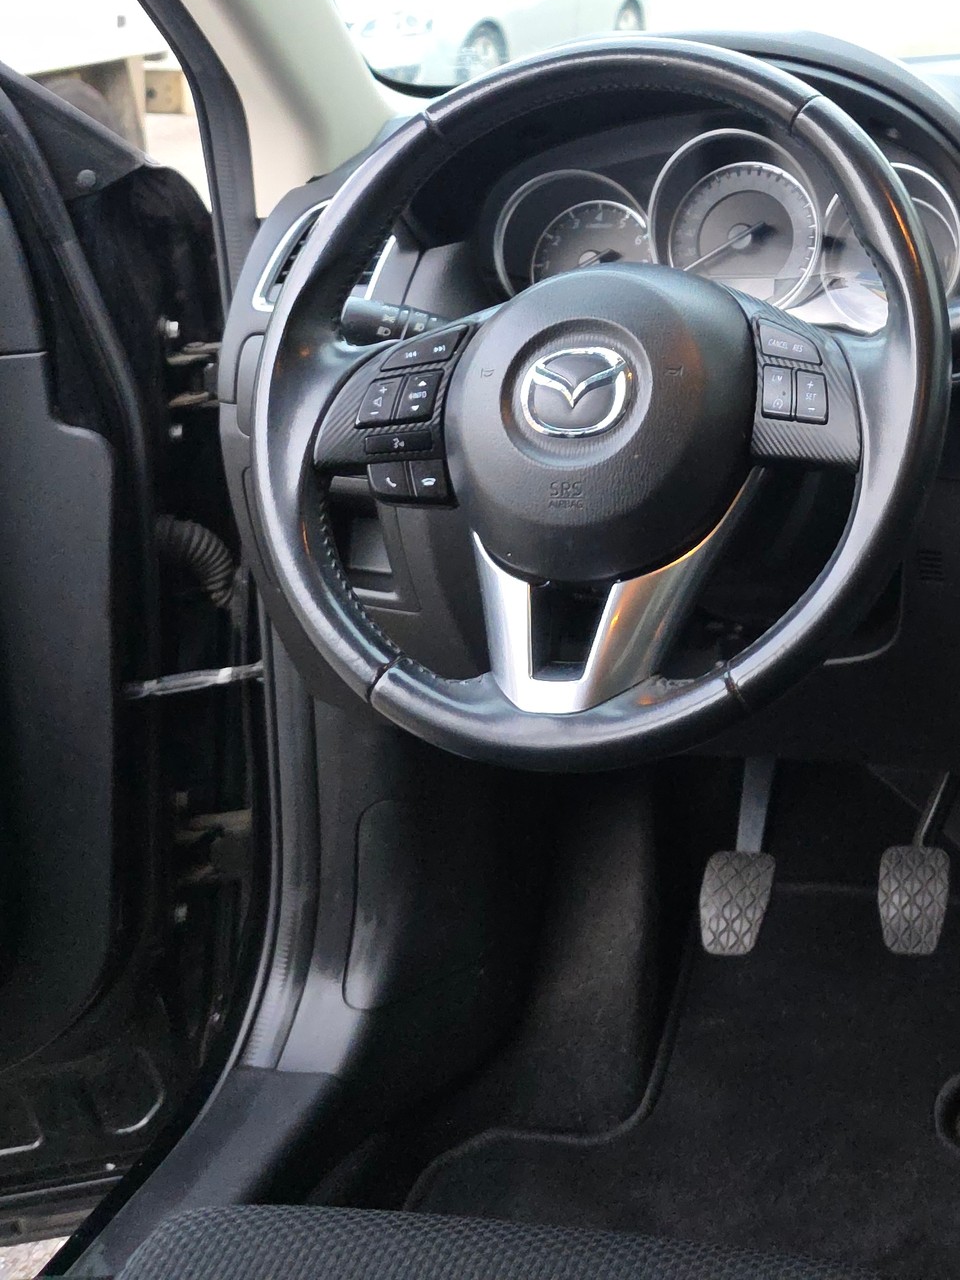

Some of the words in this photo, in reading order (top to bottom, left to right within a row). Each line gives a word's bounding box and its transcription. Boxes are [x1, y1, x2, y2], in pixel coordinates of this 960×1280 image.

[792, 343, 804, 352] RES
[805, 392, 817, 400] SET
[550, 481, 583, 497] SRS
